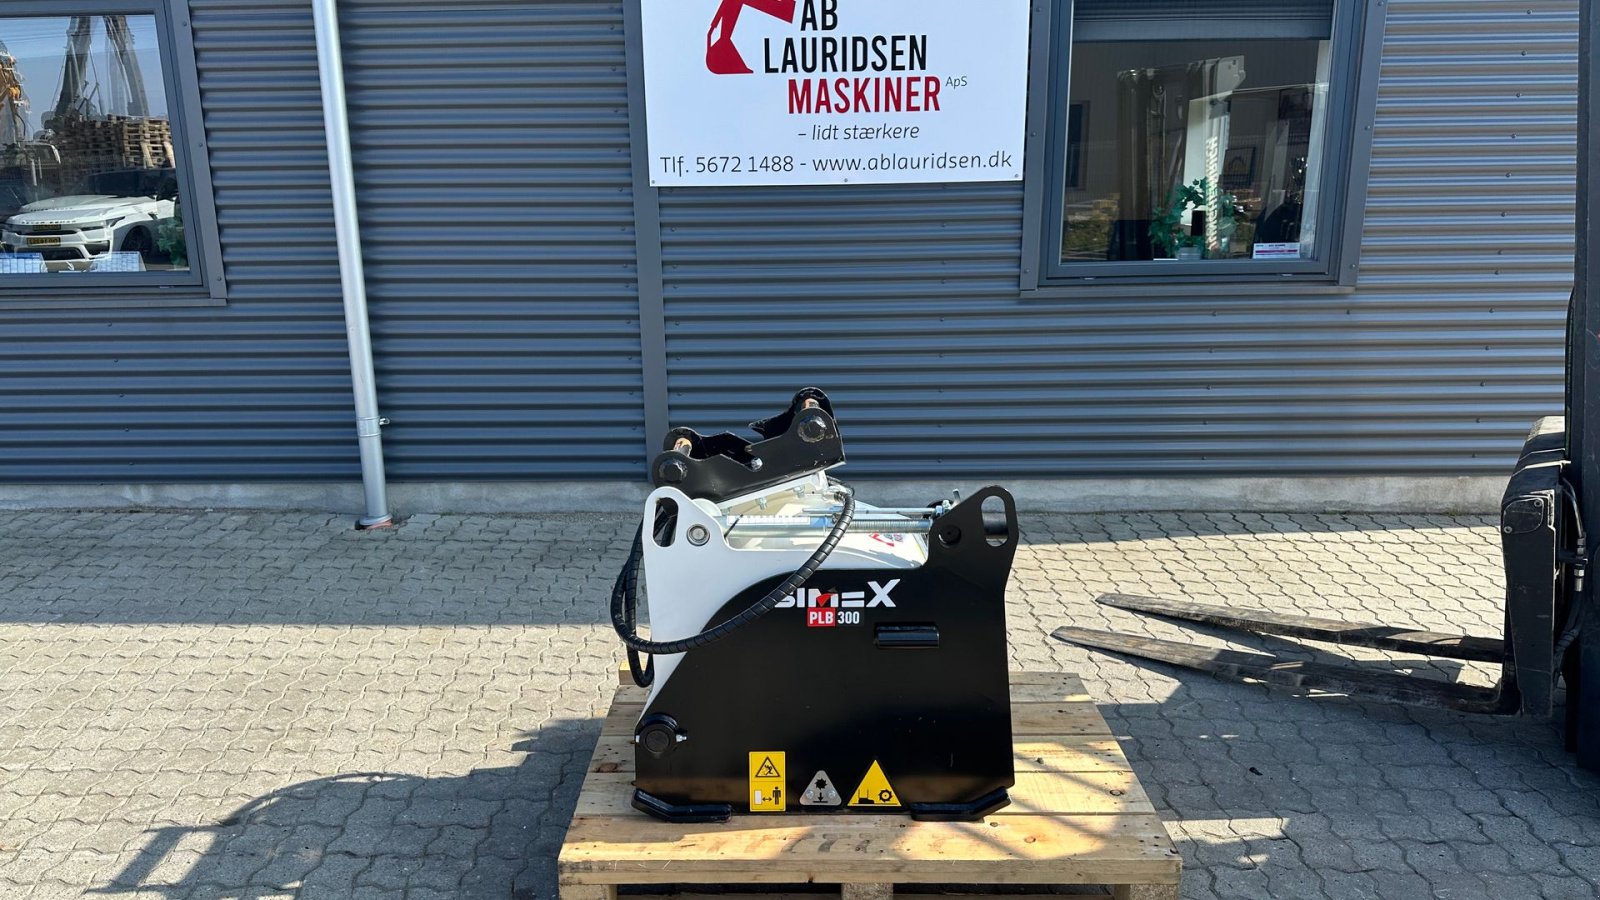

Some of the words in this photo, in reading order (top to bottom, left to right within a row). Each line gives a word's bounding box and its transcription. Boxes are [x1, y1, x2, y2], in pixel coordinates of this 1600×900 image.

[800, 0, 838, 31] AB
[764, 35, 927, 73] LAURIDSEN
[788, 76, 941, 114] MASKINER
[946, 75, 968, 88] ApS
[812, 124, 839, 140] lidt
[843, 125, 920, 140] stærkere
[660, 156, 689, 177] Tlf.
[696, 156, 742, 173] 5672
[748, 155, 794, 172] 1488
[812, 150, 1013, 172] www.ablauridsen.dk
[809, 611, 834, 624] PLB
[837, 611, 860, 624] 300
